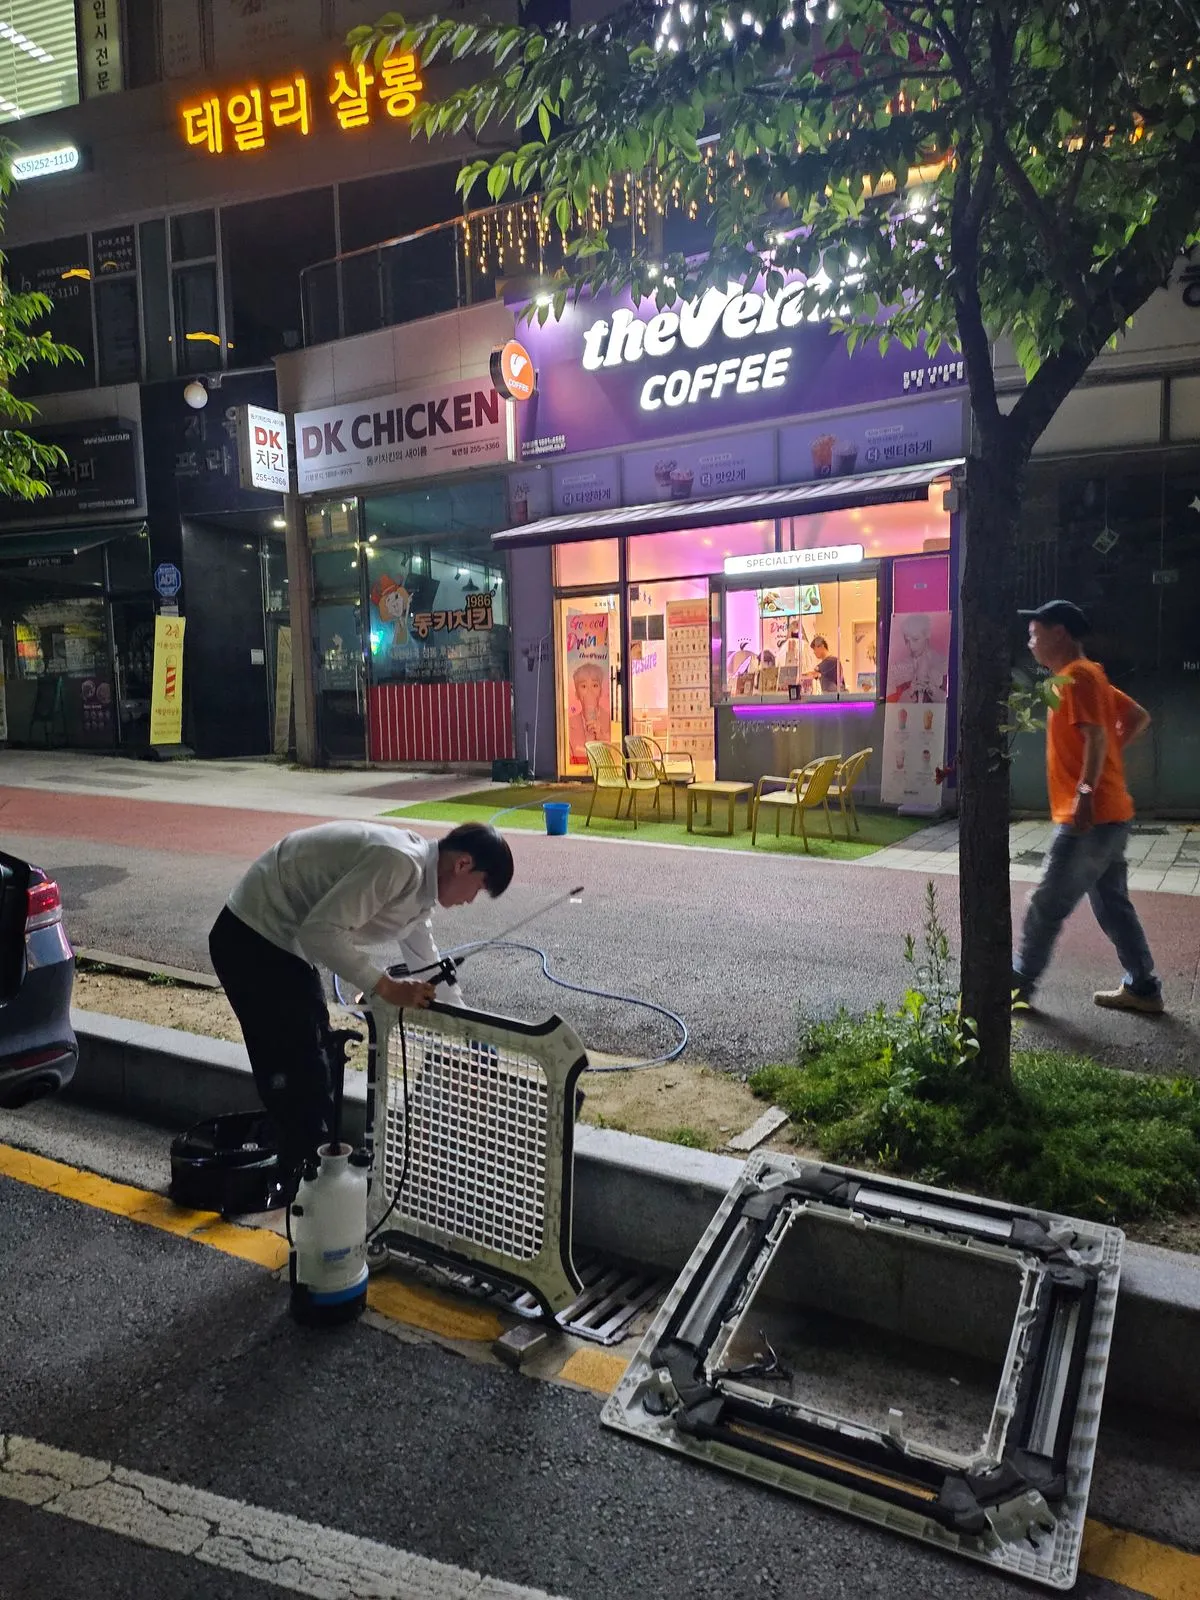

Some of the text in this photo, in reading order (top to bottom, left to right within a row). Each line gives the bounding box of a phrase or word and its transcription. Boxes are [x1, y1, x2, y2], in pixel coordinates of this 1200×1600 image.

[92, 0, 110, 90] 입시전문
[181, 55, 425, 154] 데일리 살롱
[508, 378, 530, 393] COFFEE
[640, 348, 793, 411] COFFEE
[302, 419, 347, 459] DK
[351, 388, 500, 449] CHICKEN
[254, 426, 283, 450] DK
[256, 449, 285, 472] 치킨
[366, 446, 427, 466] 동키치킨의 새이름
[883, 439, 933, 460] 벤티하게
[715, 468, 746, 484] 맛있게
[575, 487, 611, 503] 다양하게
[746, 550, 839, 568] SPECIALTY BLEND
[466, 593, 491, 608] 1986
[413, 607, 493, 638] 동키치킨
